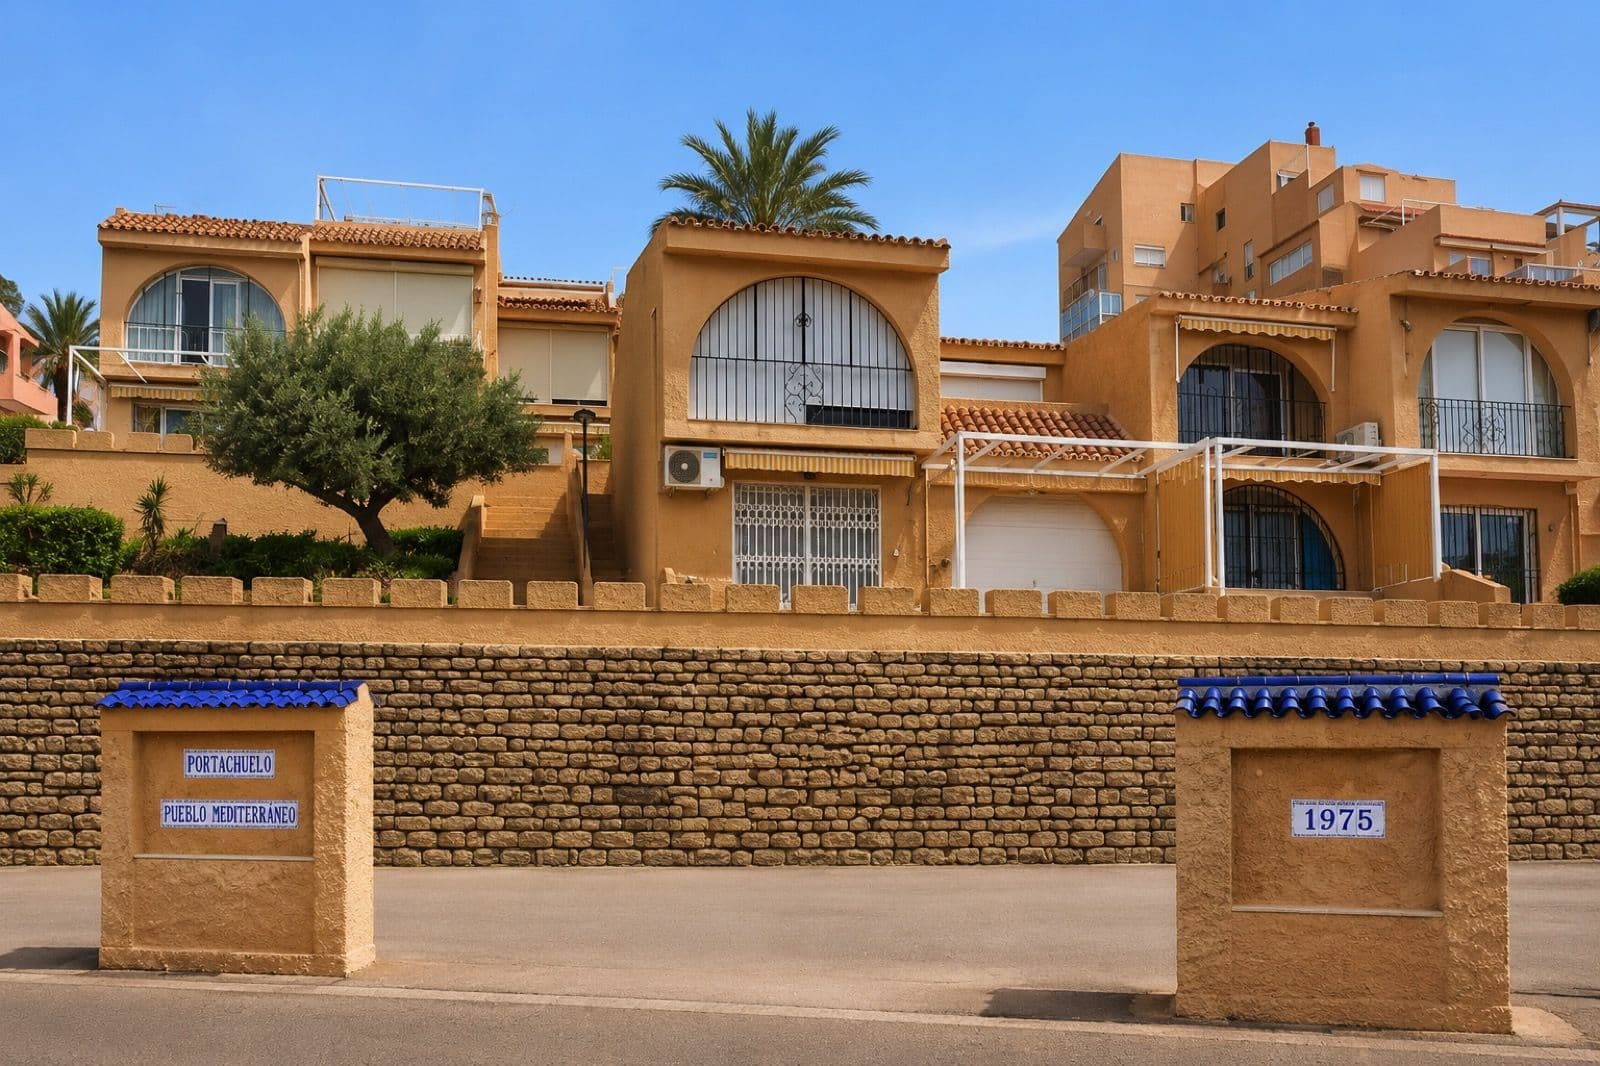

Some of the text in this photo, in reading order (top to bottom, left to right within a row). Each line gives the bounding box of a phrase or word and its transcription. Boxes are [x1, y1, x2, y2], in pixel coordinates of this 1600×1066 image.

[187, 755, 272, 773] PORTACHUELO
[164, 802, 296, 824] PUEBLO MEDITERRÁNEO
[1305, 808, 1373, 831] 1975
